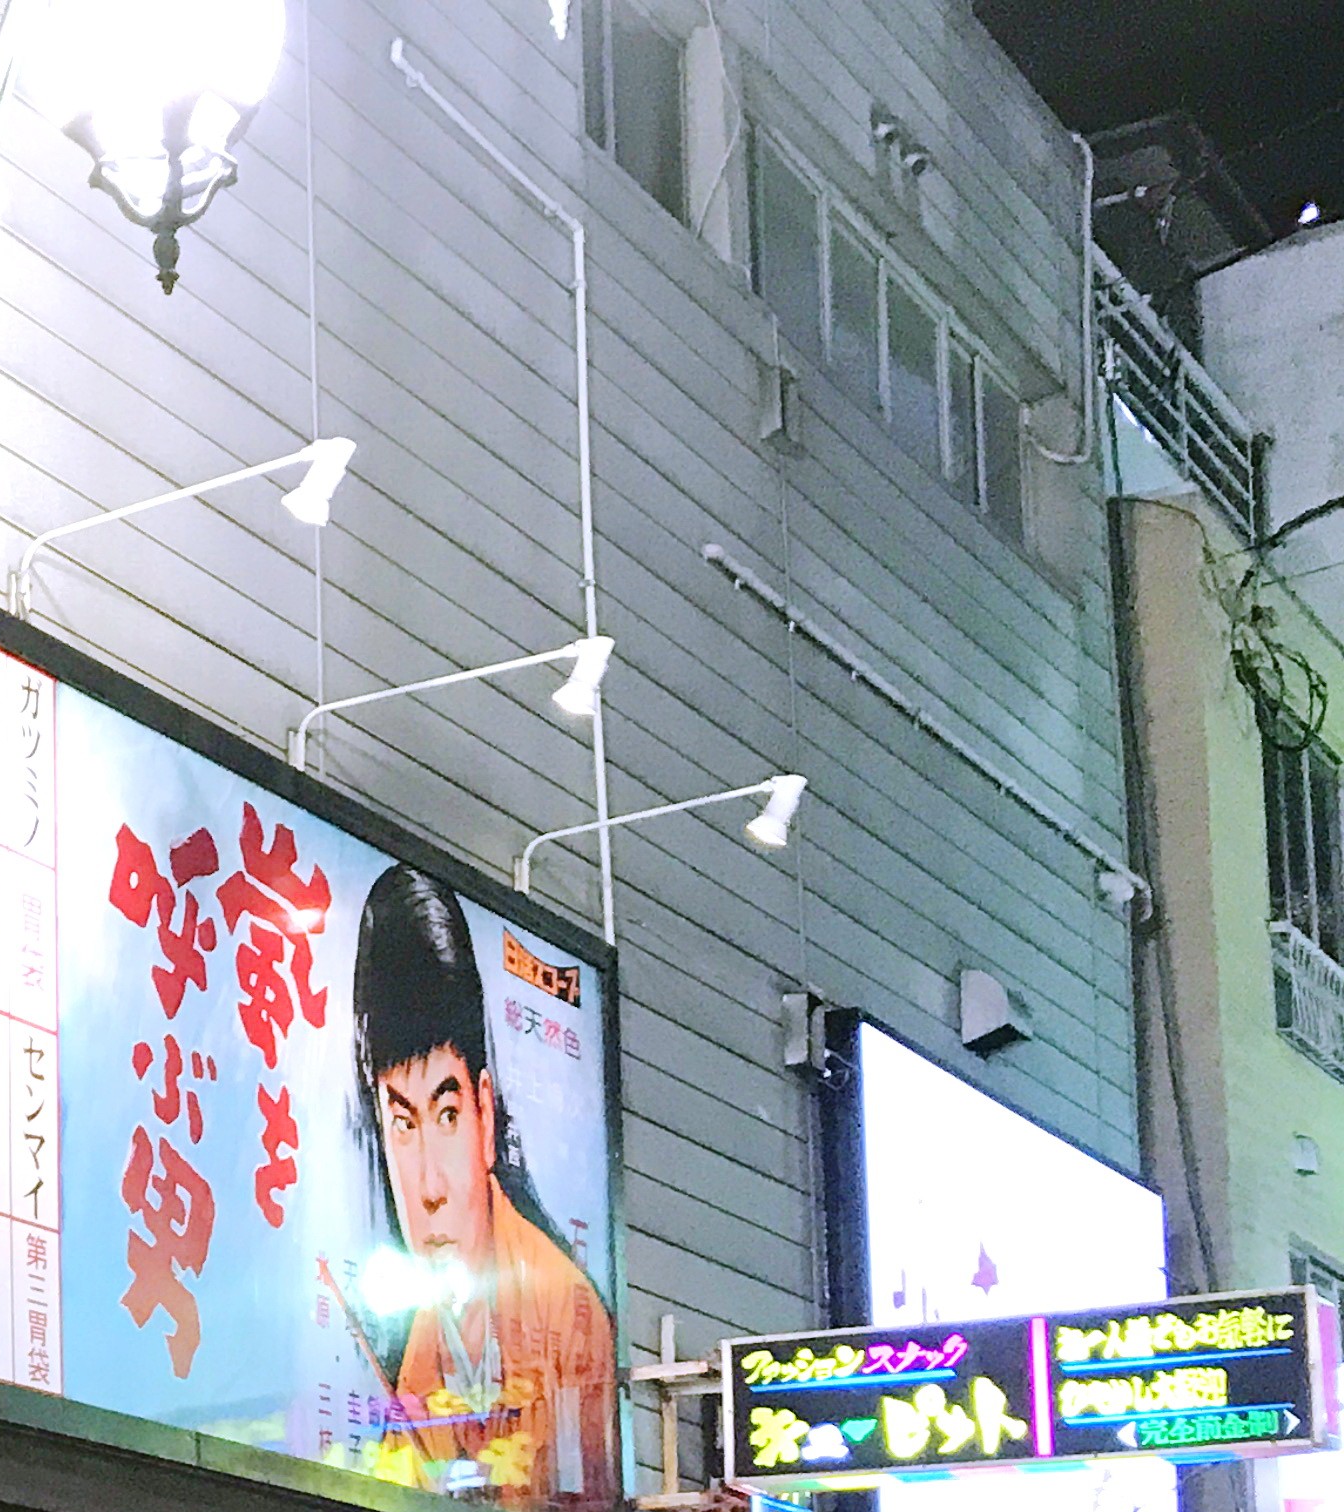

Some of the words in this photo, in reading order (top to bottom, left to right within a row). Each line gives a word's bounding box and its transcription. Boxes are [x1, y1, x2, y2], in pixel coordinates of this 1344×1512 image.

[23, 1036, 47, 1220] センマイ
[108, 823, 224, 1380] 呼ぶ男
[216, 800, 333, 1230] 嵐を
[25, 1232, 51, 1387] 第三胃袋
